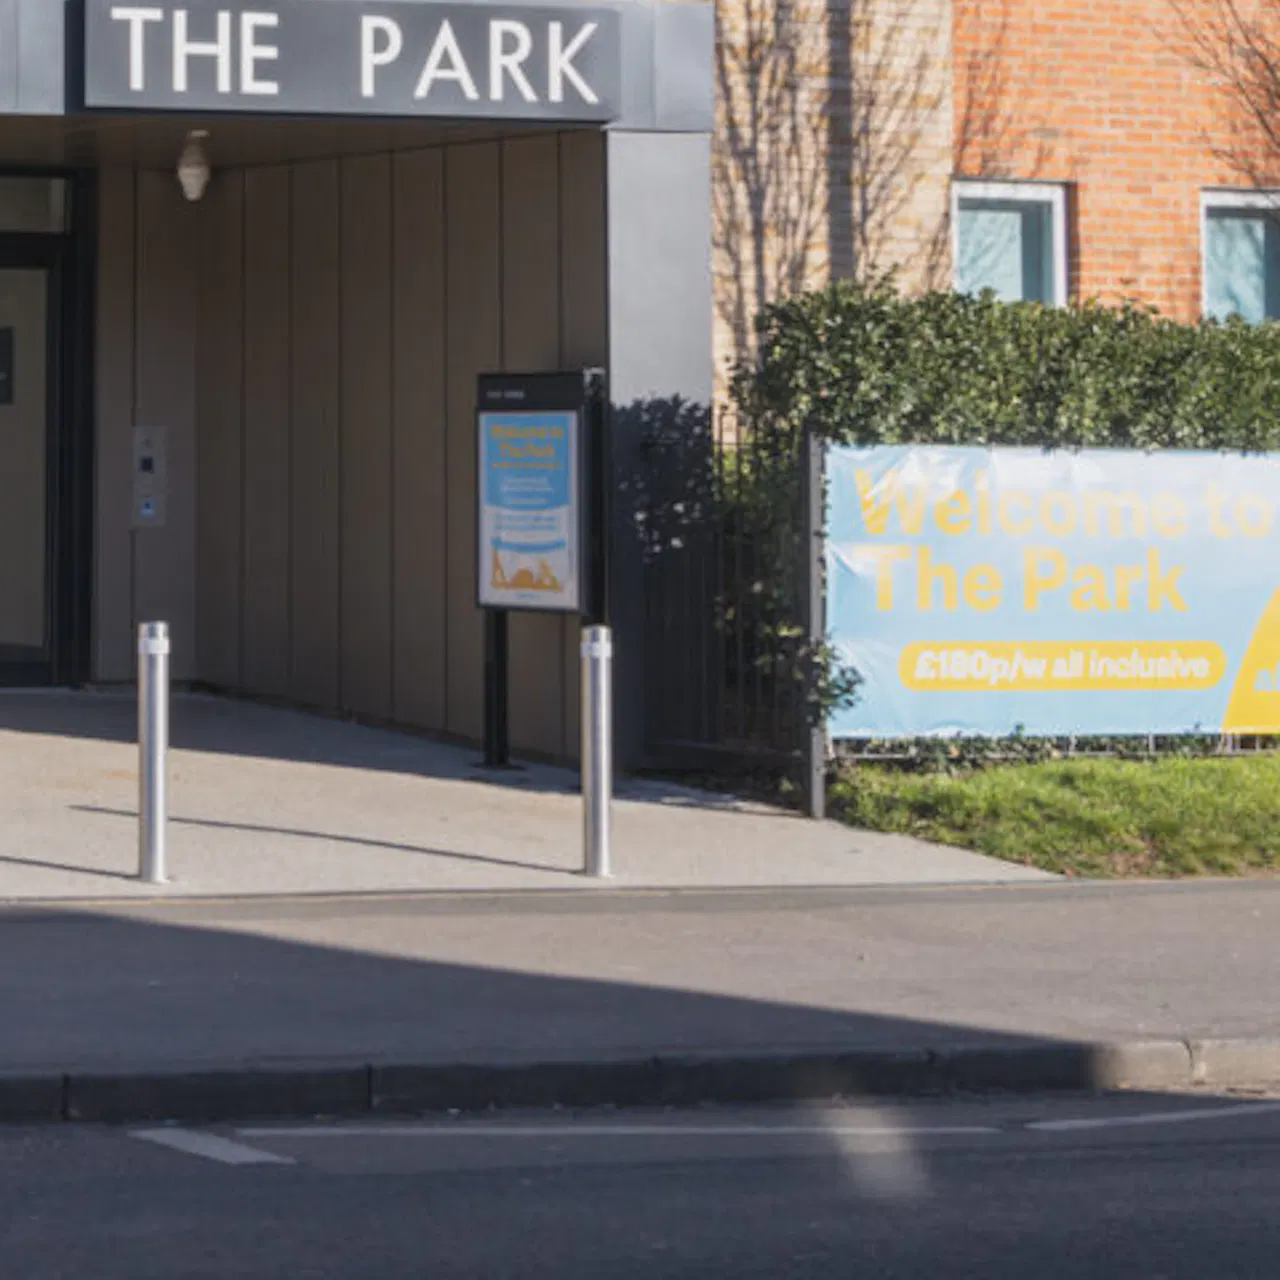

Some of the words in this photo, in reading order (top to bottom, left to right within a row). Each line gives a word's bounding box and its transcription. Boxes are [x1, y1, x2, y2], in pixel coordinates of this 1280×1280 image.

[111, 7, 280, 96] THE
[360, 14, 600, 104] PARK
[854, 468, 1188, 538] Welcome
[1207, 480, 1275, 539] to
[853, 543, 1003, 613] The
[1022, 546, 1190, 614] Park
[1051, 648, 1084, 678] all
[1089, 648, 1210, 679] inclusive
